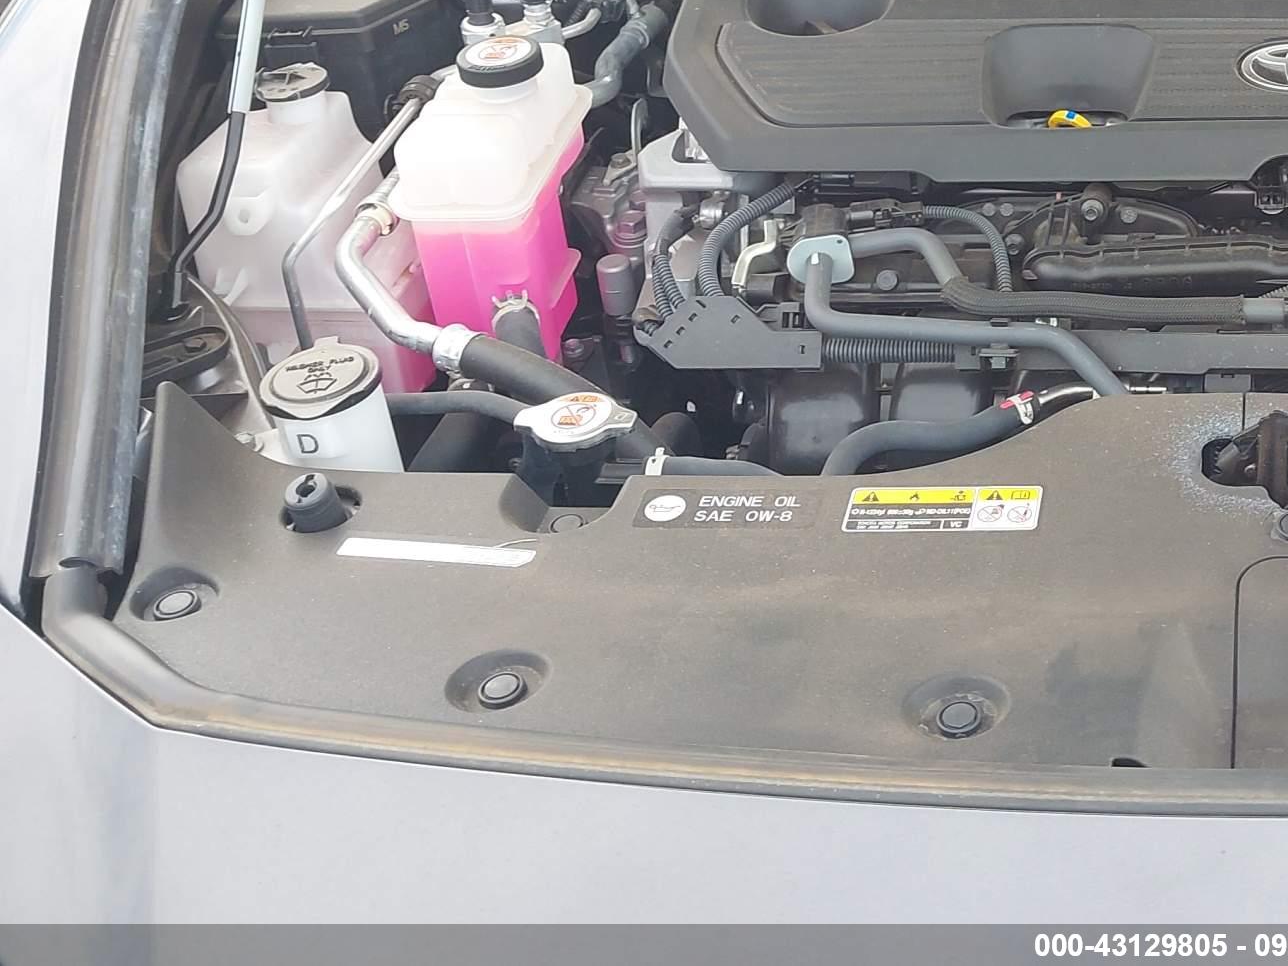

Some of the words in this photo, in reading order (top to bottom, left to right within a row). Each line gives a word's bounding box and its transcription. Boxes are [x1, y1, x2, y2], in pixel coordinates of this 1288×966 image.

[296, 434, 319, 454] D
[698, 495, 765, 507] ENGINE
[774, 496, 801, 507] OIL
[693, 510, 735, 522] SAE
